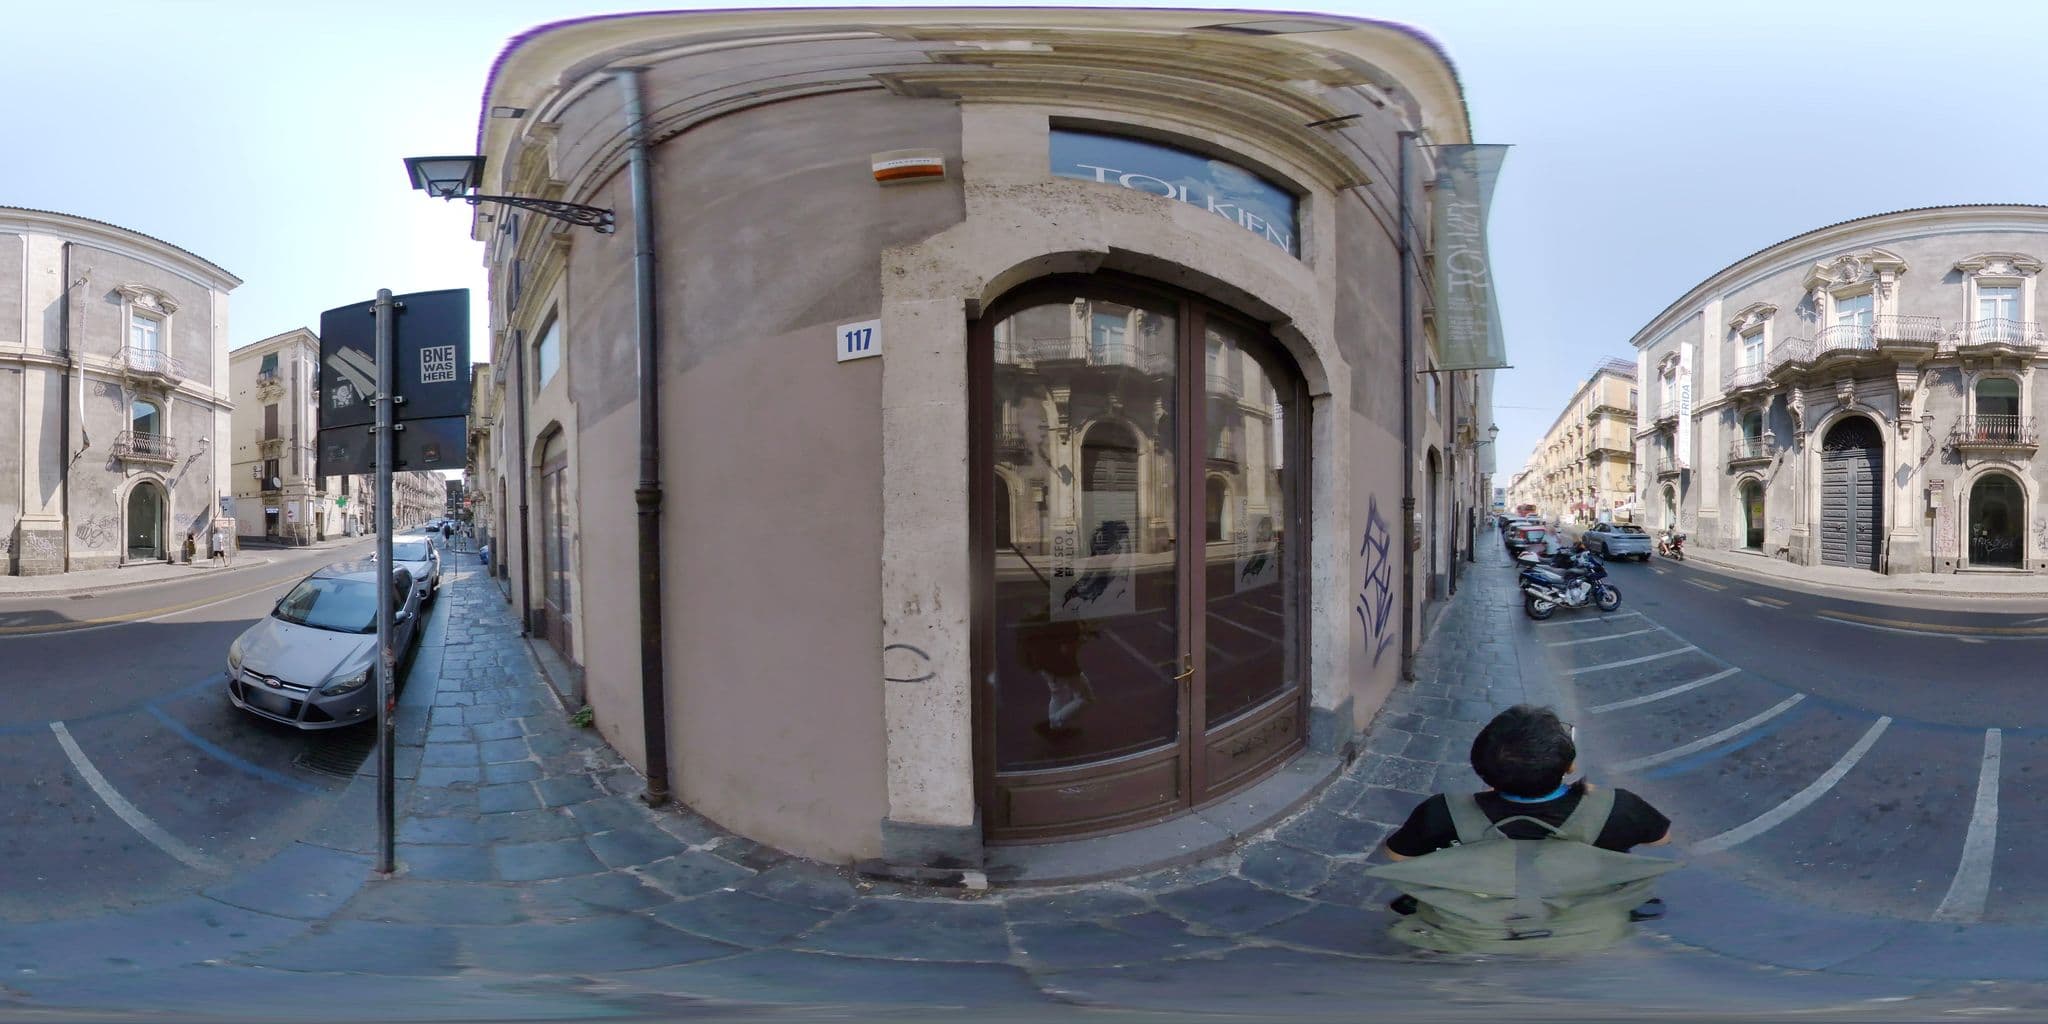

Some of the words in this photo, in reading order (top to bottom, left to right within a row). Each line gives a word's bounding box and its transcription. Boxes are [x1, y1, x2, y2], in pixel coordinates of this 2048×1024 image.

[845, 328, 872, 353] 117
[423, 347, 453, 363] BNE
[423, 362, 453, 372] WAS
[423, 371, 454, 381] HERE
[1681, 384, 1690, 416] FRIDA
